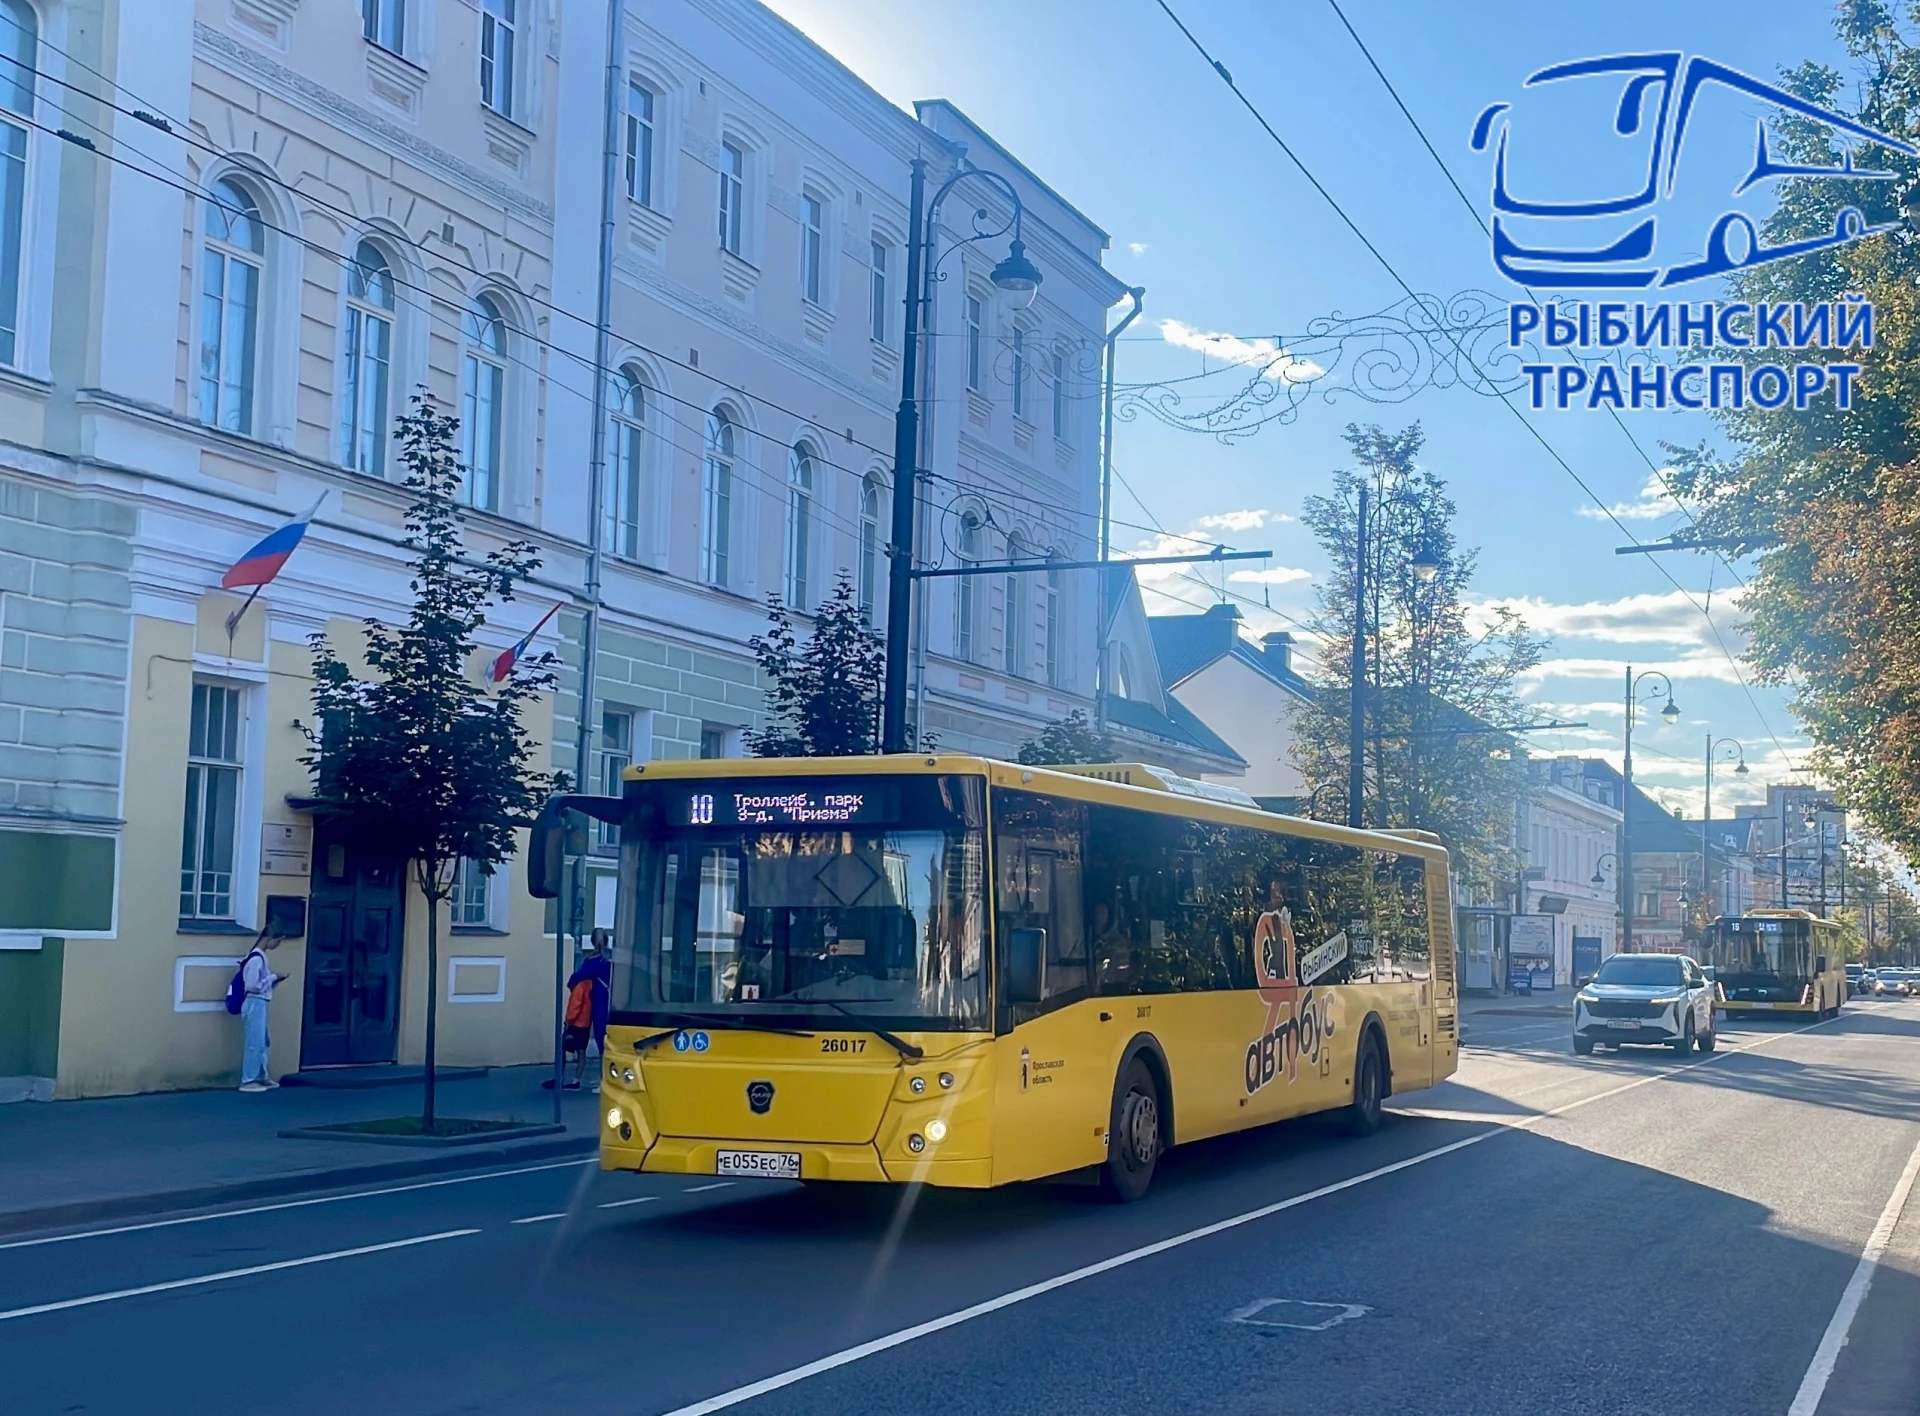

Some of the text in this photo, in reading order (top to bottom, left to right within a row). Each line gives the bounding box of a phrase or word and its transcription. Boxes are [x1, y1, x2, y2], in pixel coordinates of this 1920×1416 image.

[691, 794, 713, 824] 10
[733, 793, 863, 808] Троллейб. парк
[1302, 933, 1346, 979] РЫБИНСКИЙ
[821, 1039, 867, 1053] 26017
[1245, 986, 1335, 1094] автобус
